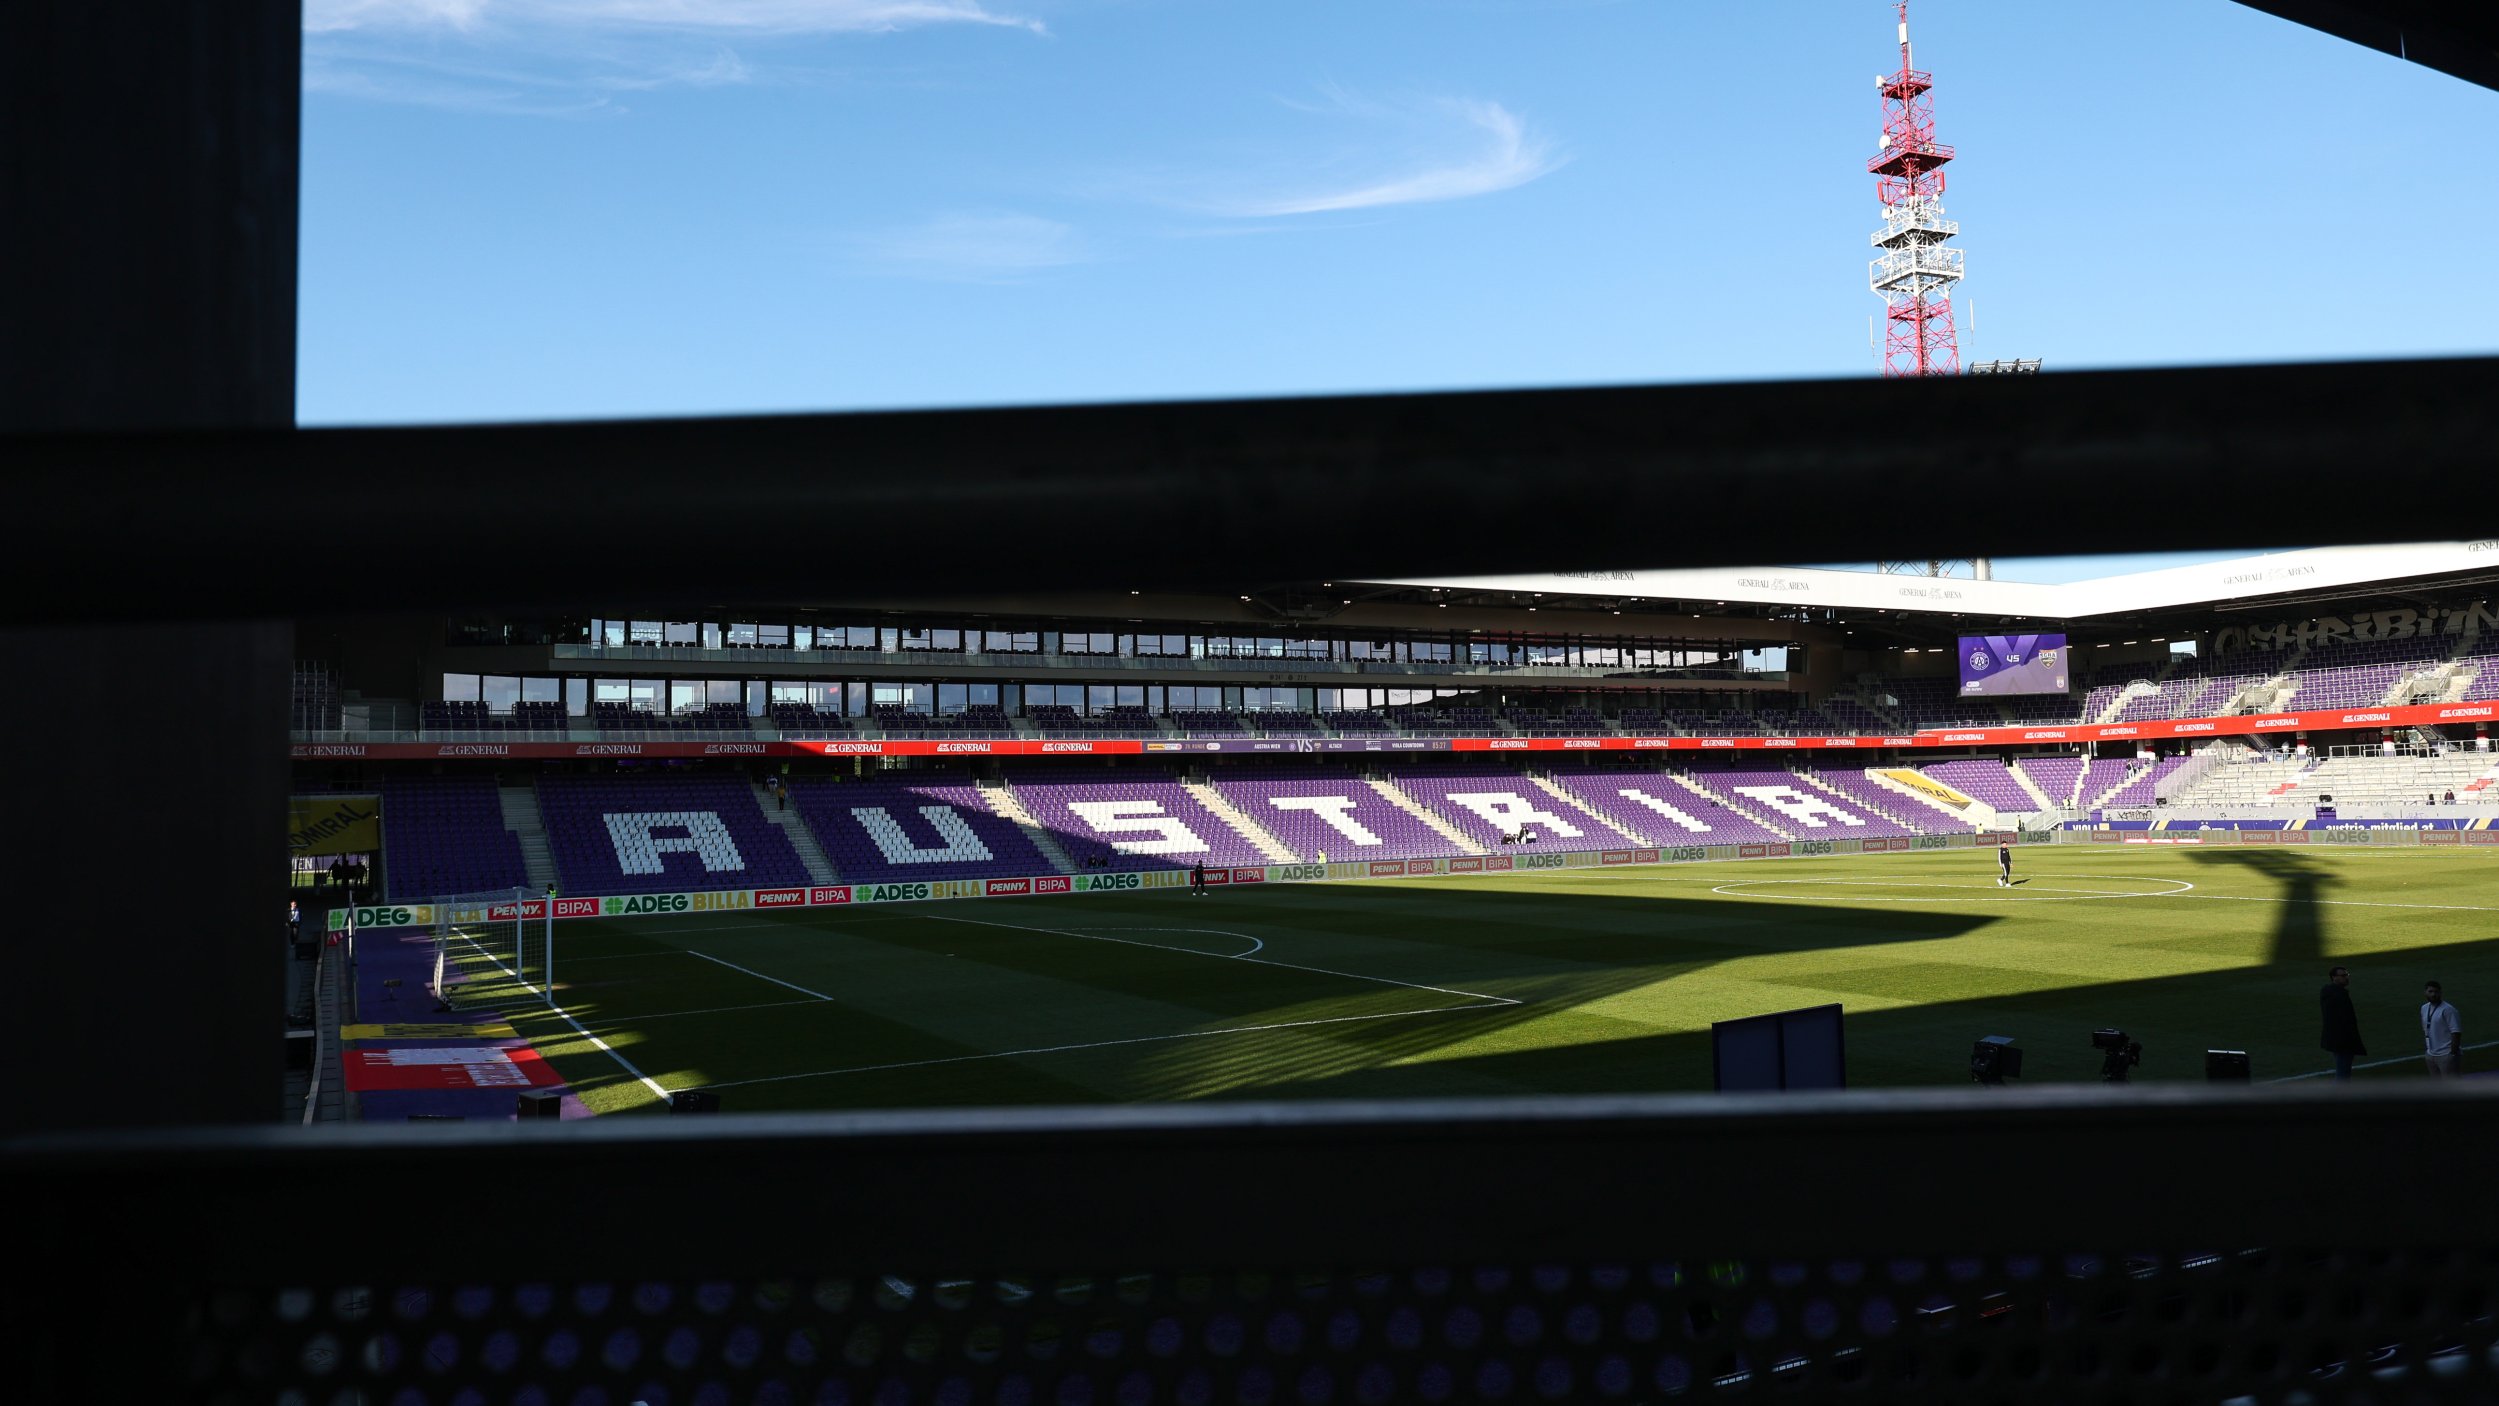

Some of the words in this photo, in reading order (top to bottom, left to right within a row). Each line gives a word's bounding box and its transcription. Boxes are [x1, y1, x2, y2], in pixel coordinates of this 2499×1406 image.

[1610, 571, 1635, 581] ARENA
[2223, 572, 2263, 585] GENERALI
[2287, 565, 2316, 576] ARENA
[1737, 578, 1770, 589] GENERALI
[1788, 581, 1810, 591] ARENA
[1898, 588, 1927, 597] GENERALI
[1944, 591, 1962, 599] ARENA
[2353, 712, 2390, 723] GENERALI
[2451, 706, 2492, 718] GENERALI
[2184, 722, 2214, 731] GENERALI
[2264, 718, 2298, 727] GENERALI
[2034, 731, 2066, 739] GENERALI
[2108, 726, 2137, 735] GENERALI
[1772, 738, 1796, 746] GENERALI
[1832, 738, 1856, 746] GENERALI
[1890, 738, 1912, 746] GENERALI
[1952, 734, 1985, 742] GENERALI
[592, 744, 642, 754] GENERALI
[720, 744, 766, 754] GENERALI
[838, 743, 882, 752] GENERALI
[949, 743, 991, 752] GENERALI
[1054, 743, 1093, 752] GENERALI
[1297, 739, 1312, 752] VS
[1500, 740, 1528, 749] GENERALI
[1572, 740, 1600, 748] GENERALI
[1642, 740, 1669, 748] GENERALI
[308, 746, 366, 756] GENERALI
[455, 745, 508, 756] GENERALI
[1948, 835, 1973, 846] BILLA
[2002, 834, 2016, 843] BIPA
[2026, 832, 2050, 842] ADEG
[2163, 832, 2200, 840] ADEG
[2282, 832, 2306, 841] BIPA
[2326, 831, 2370, 842] ADEG
[2372, 831, 2414, 843] BILLA
[2468, 832, 2496, 842] BIPA
[1834, 840, 1860, 852] BILLA
[1891, 840, 1908, 848] BIPA
[1920, 836, 1947, 848] ADEG
[1707, 847, 1737, 860] BILLA
[1771, 845, 1789, 854] BIPA
[1801, 842, 1832, 854] ADEG
[1566, 852, 1598, 866] BILLA
[1637, 852, 1657, 861] BIPA
[1672, 848, 1704, 860] ADEG
[1488, 858, 1510, 869] BIPA
[1526, 854, 1564, 868] ADEG
[1328, 863, 1366, 878] BILLA
[1411, 862, 1433, 872] BIPA
[1236, 870, 1260, 880] BIPA
[1281, 866, 1324, 880] ADEG
[1039, 880, 1066, 891] BIPA
[1090, 874, 1139, 890] ADEG
[1143, 872, 1185, 888] BILLA
[873, 883, 928, 902] ADEG
[932, 880, 982, 898] BILLA
[815, 890, 846, 902] BIPA
[624, 894, 688, 914] ADEG
[692, 892, 750, 912] BILLA
[557, 902, 593, 914] BIPA
